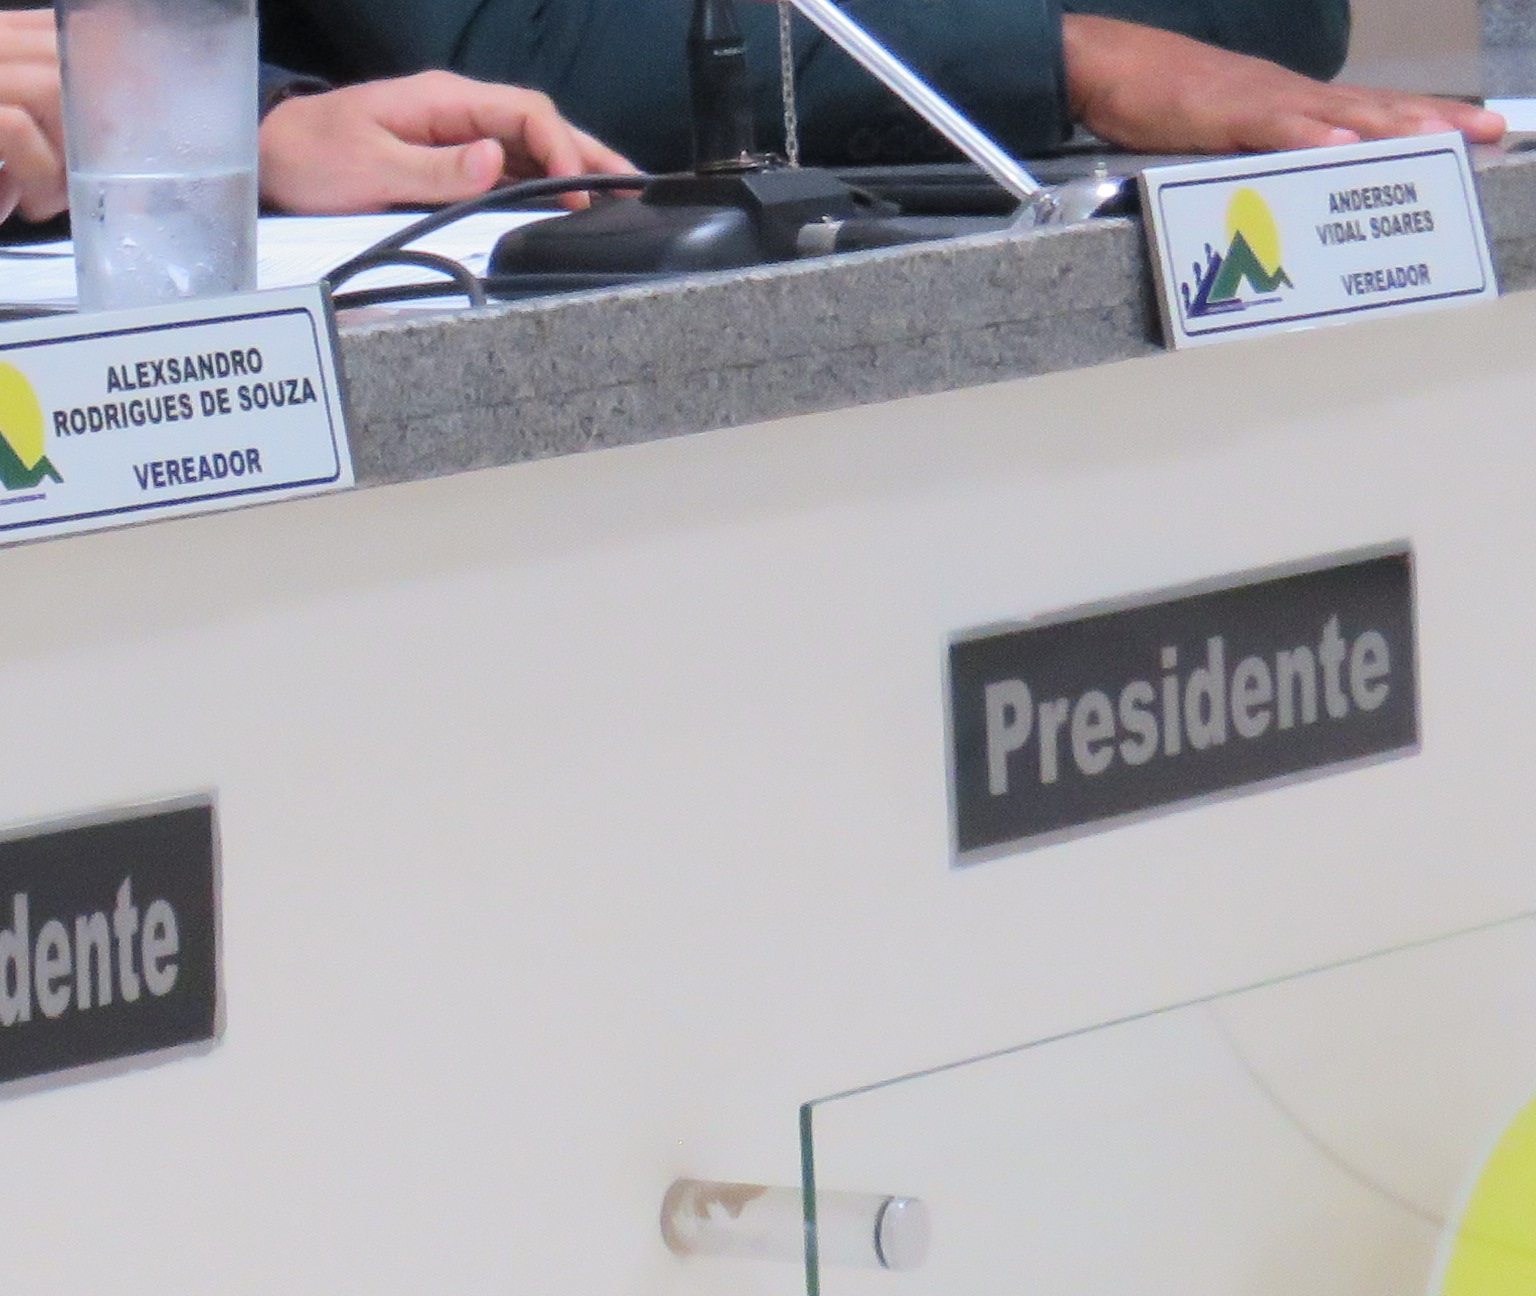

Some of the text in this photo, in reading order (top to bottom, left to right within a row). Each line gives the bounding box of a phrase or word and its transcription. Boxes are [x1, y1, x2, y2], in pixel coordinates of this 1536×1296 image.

[1330, 183, 1417, 213] ANDERSON
[1316, 210, 1434, 245] VIDAL SOARES
[1342, 264, 1430, 295] VEREADOR
[106, 347, 263, 393] ALEXSANDRO
[53, 378, 317, 437] RODRIGUES DE SOUZA
[133, 448, 262, 490] VEREADOR
[984, 613, 1391, 795] Presidente
